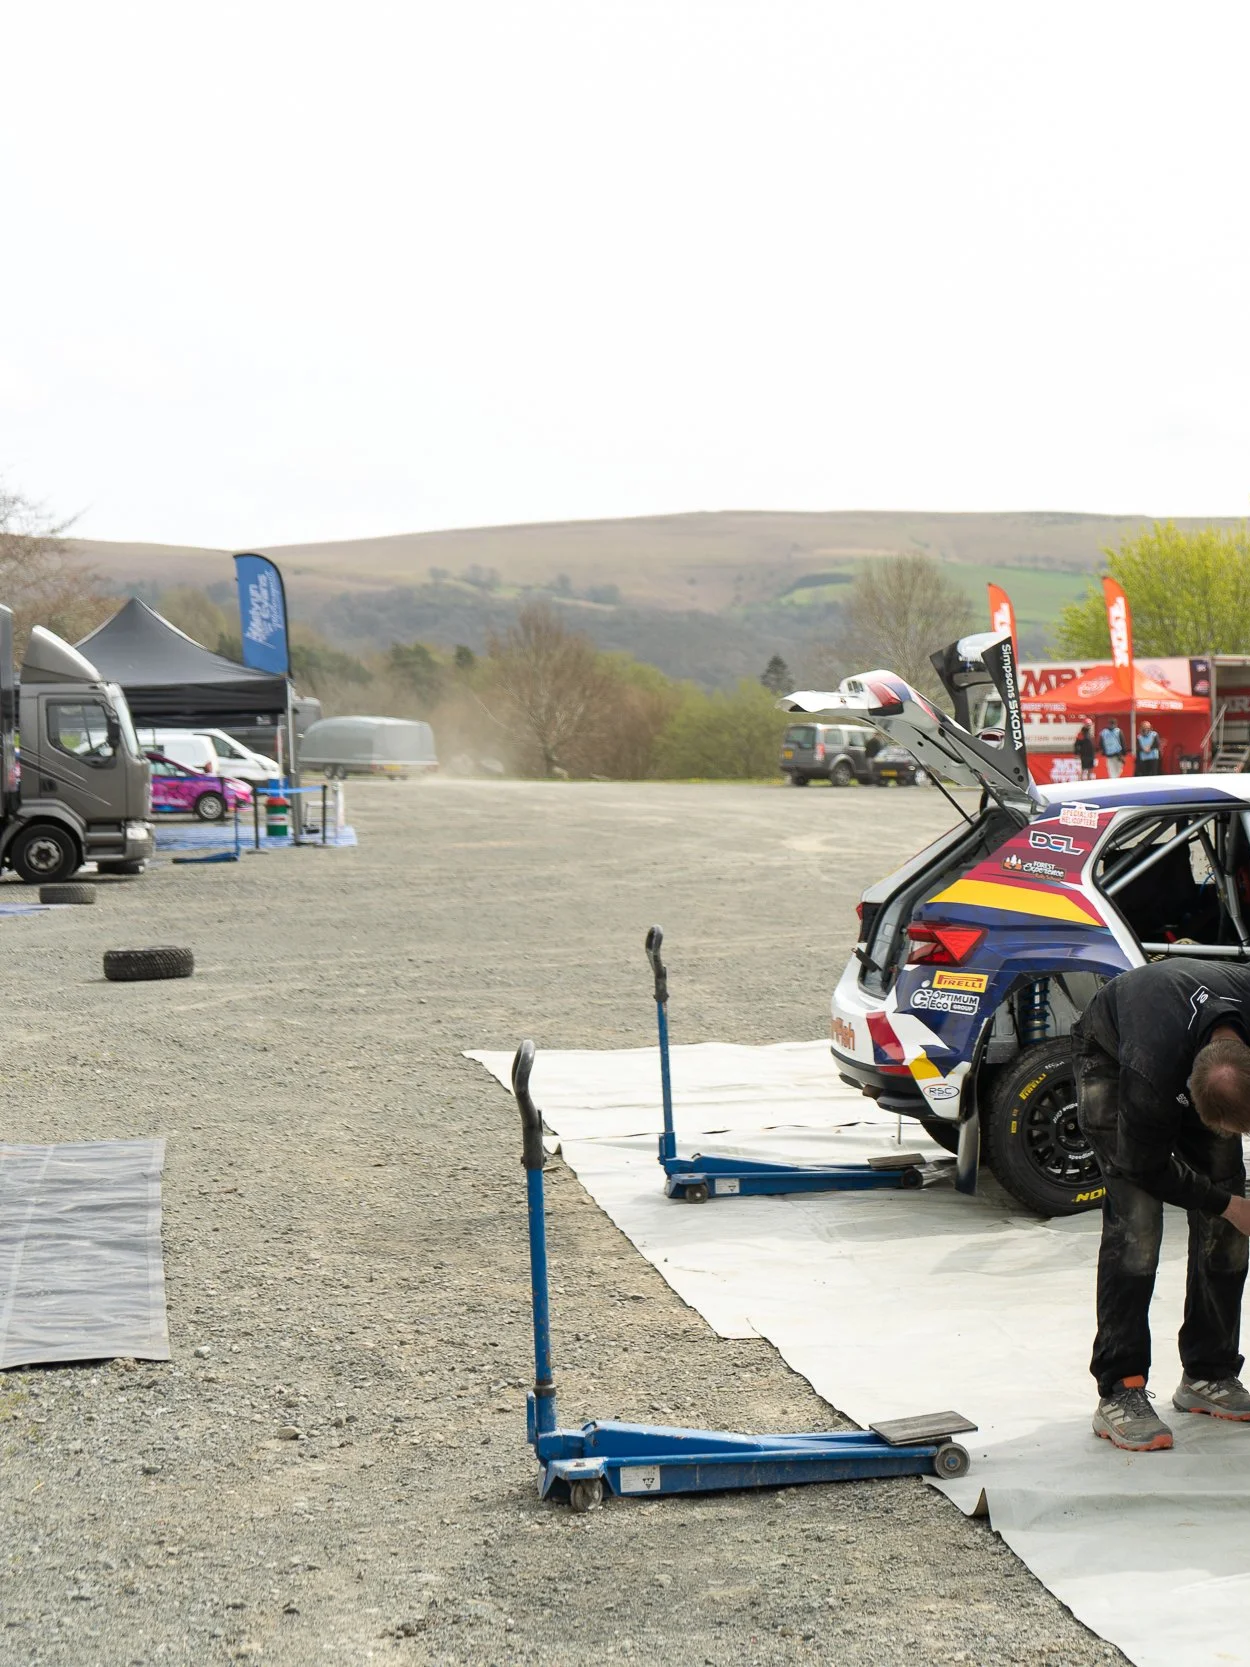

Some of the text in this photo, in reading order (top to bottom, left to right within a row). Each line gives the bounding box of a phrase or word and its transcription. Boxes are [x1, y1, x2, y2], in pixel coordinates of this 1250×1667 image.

[1001, 643, 1014, 698] Simpsons
[1062, 809, 1097, 819] SPECIALIST
[1061, 817, 1096, 826] HELICOPTERS
[1031, 832, 1082, 854] DCL
[1033, 861, 1056, 869] FOREST
[937, 974, 984, 988] PIRELLI
[932, 991, 977, 1005] OPTIMUM
